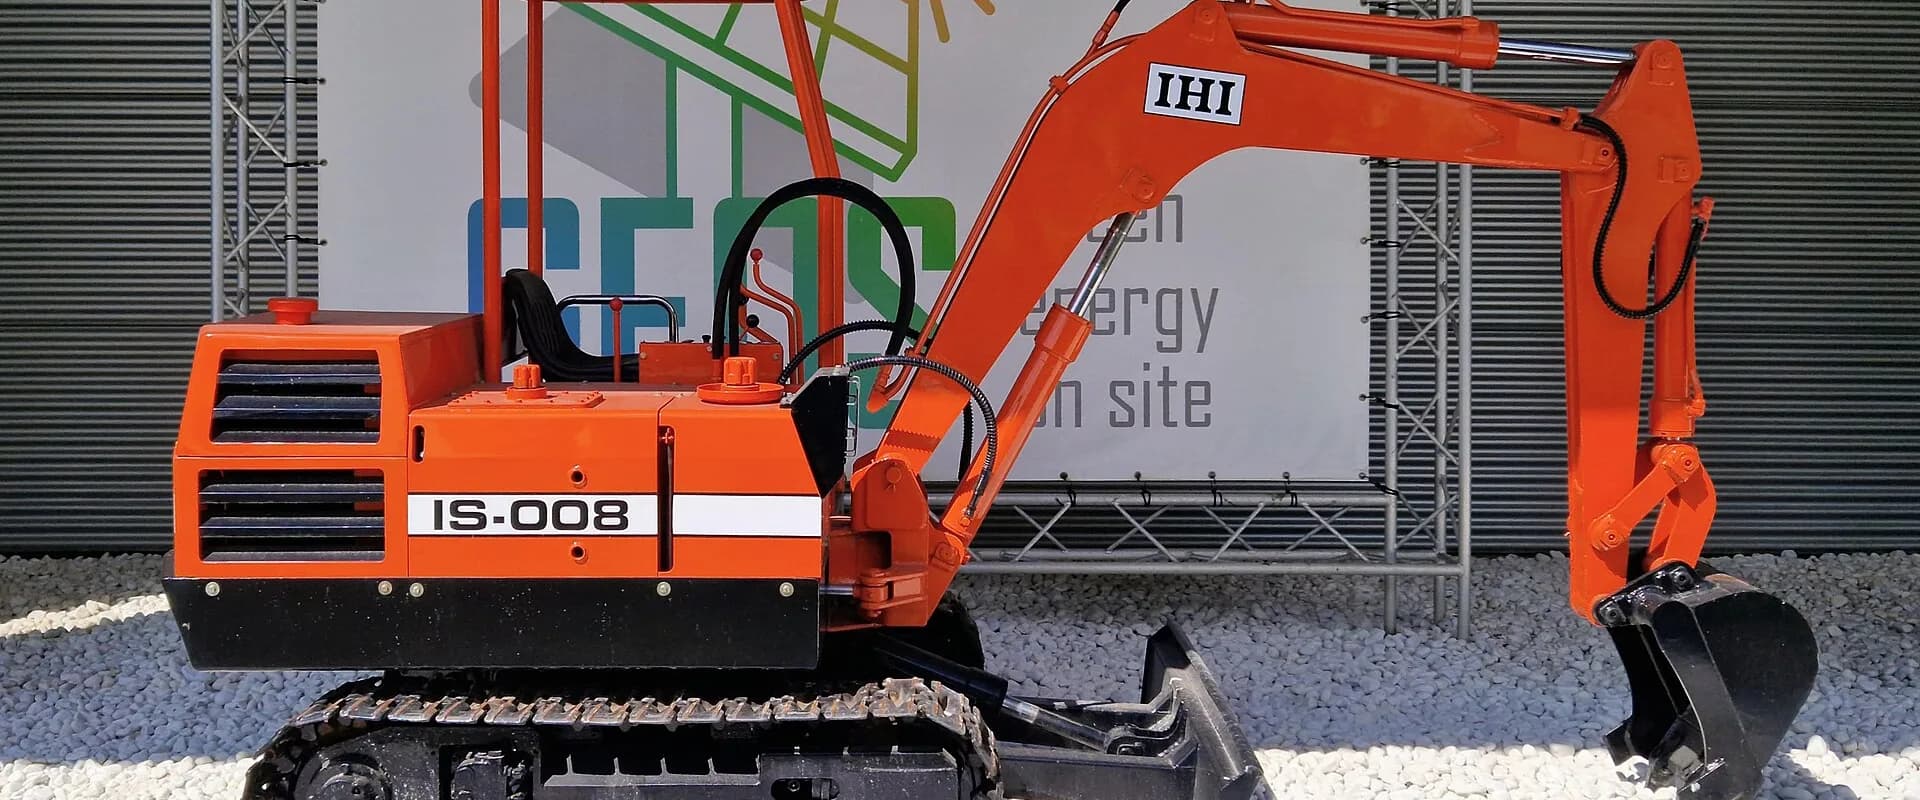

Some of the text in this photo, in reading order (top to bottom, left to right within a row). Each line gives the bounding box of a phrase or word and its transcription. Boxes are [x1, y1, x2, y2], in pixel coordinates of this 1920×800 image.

[1154, 71, 1236, 116] IHI
[1019, 287, 1219, 354] eergy
[1032, 362, 1212, 428] n site
[433, 499, 629, 531] IS-008
